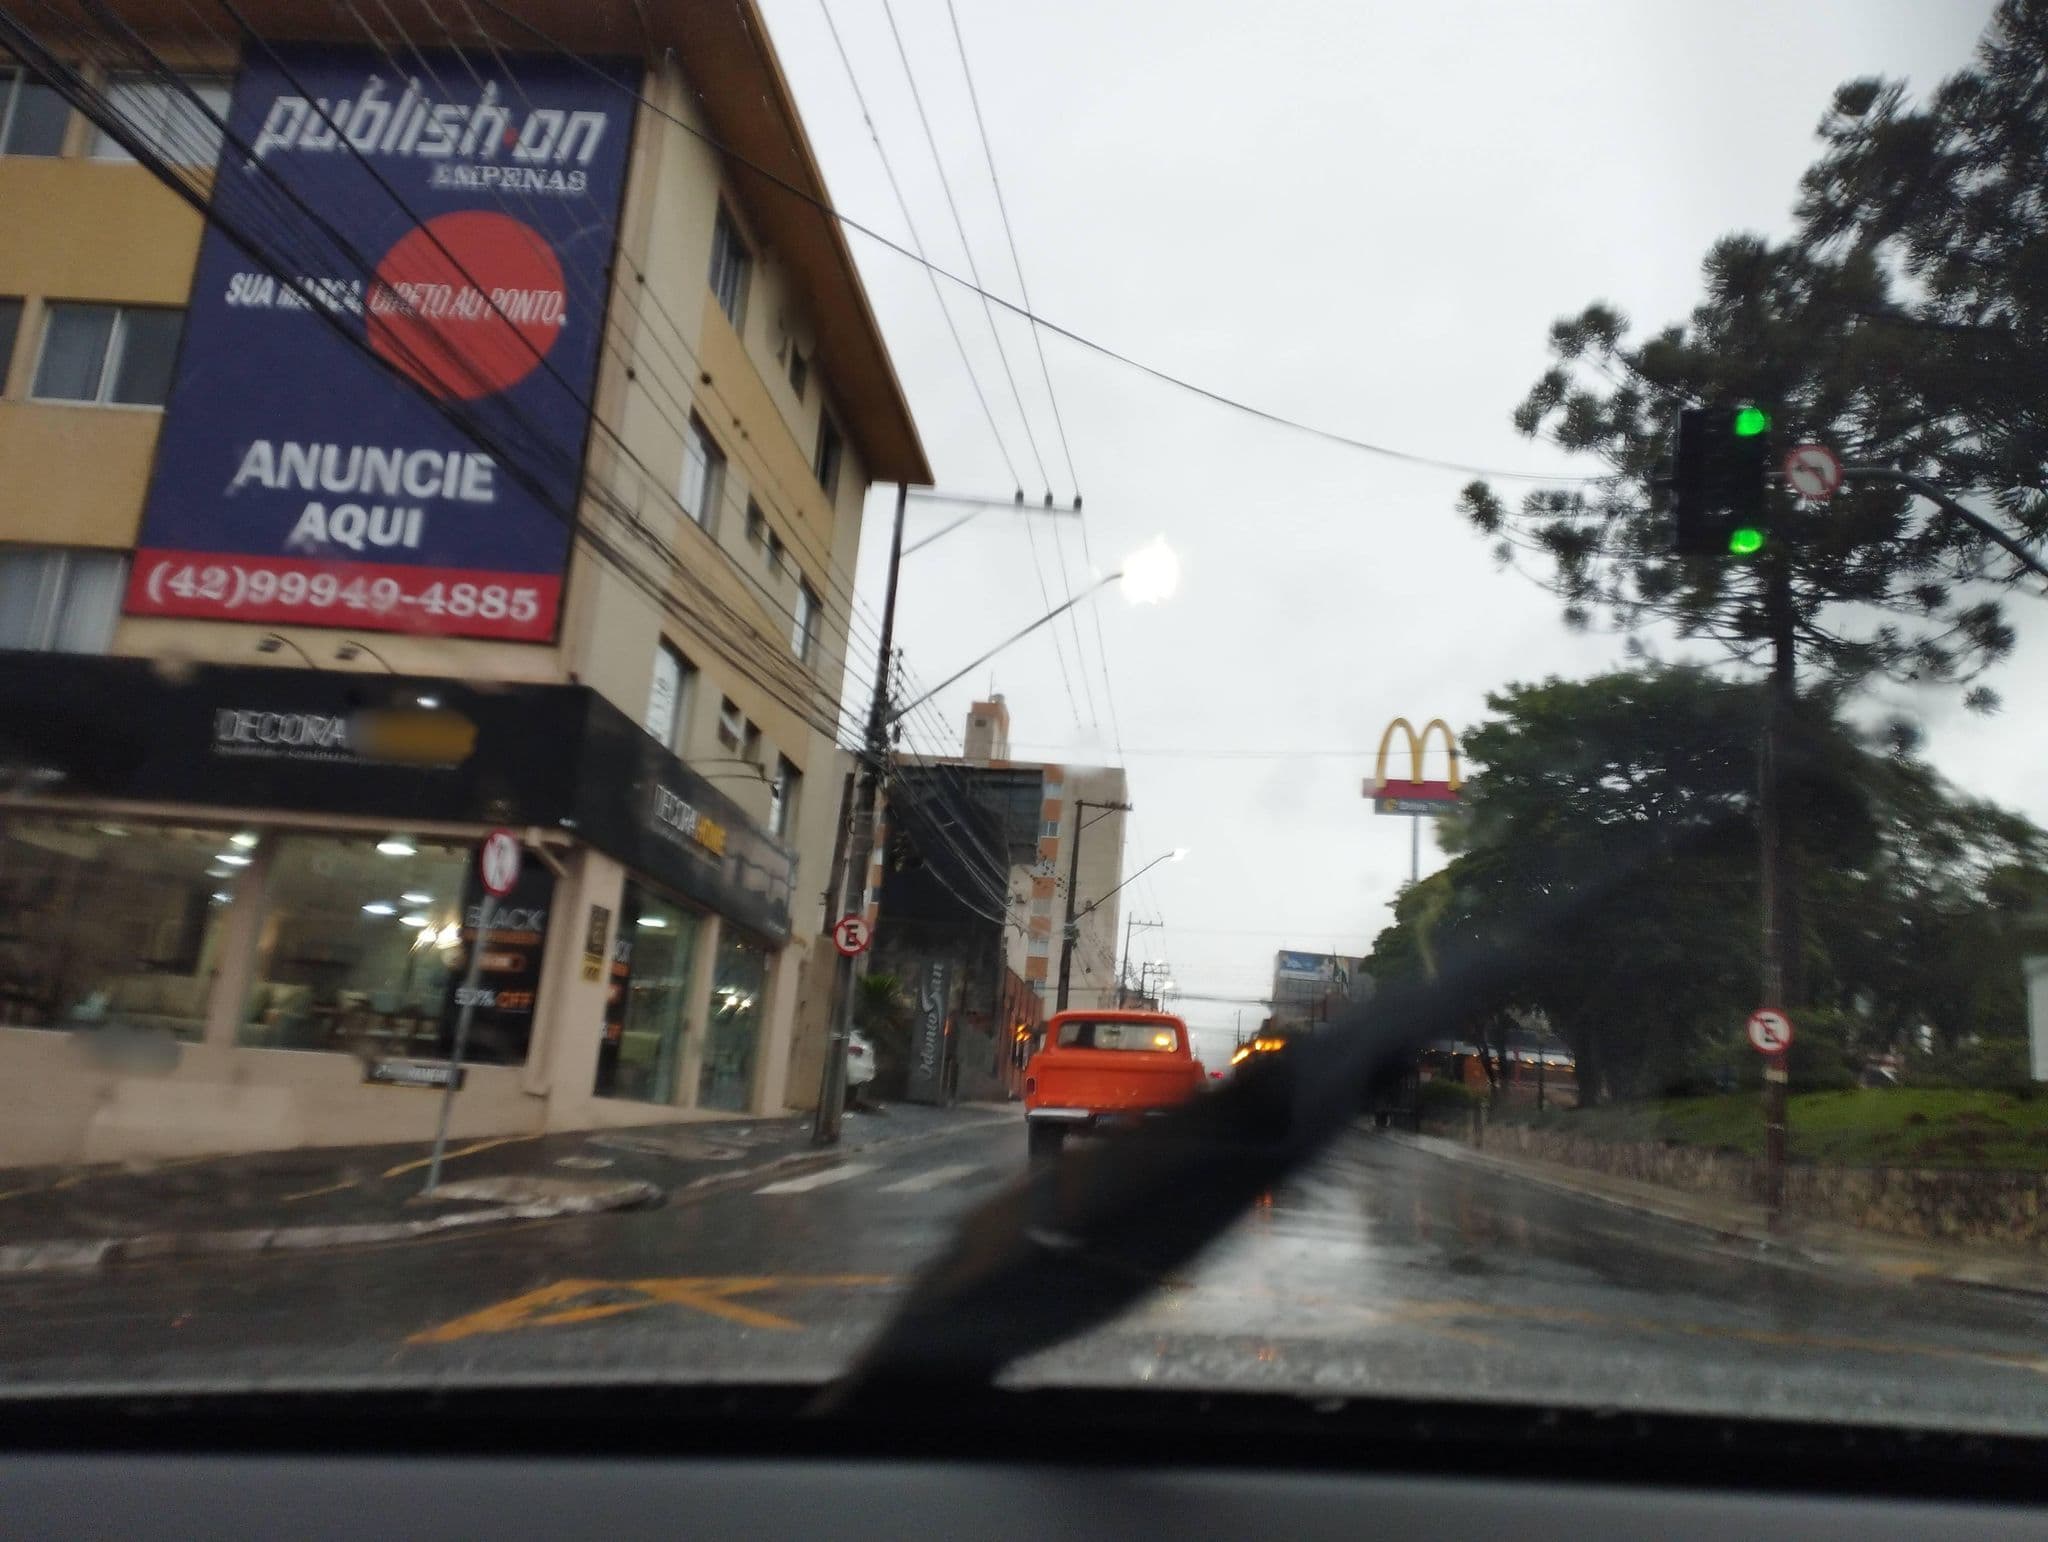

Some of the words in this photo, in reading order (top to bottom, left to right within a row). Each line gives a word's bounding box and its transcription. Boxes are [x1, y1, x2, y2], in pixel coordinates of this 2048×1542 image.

[432, 164, 588, 193] EMPENAS
[225, 272, 275, 308] SUA
[228, 439, 497, 502] ANUNCIE
[286, 501, 424, 550] AQUI
[146, 561, 539, 623] (42)99949-4885
[464, 905, 544, 931] BACK
